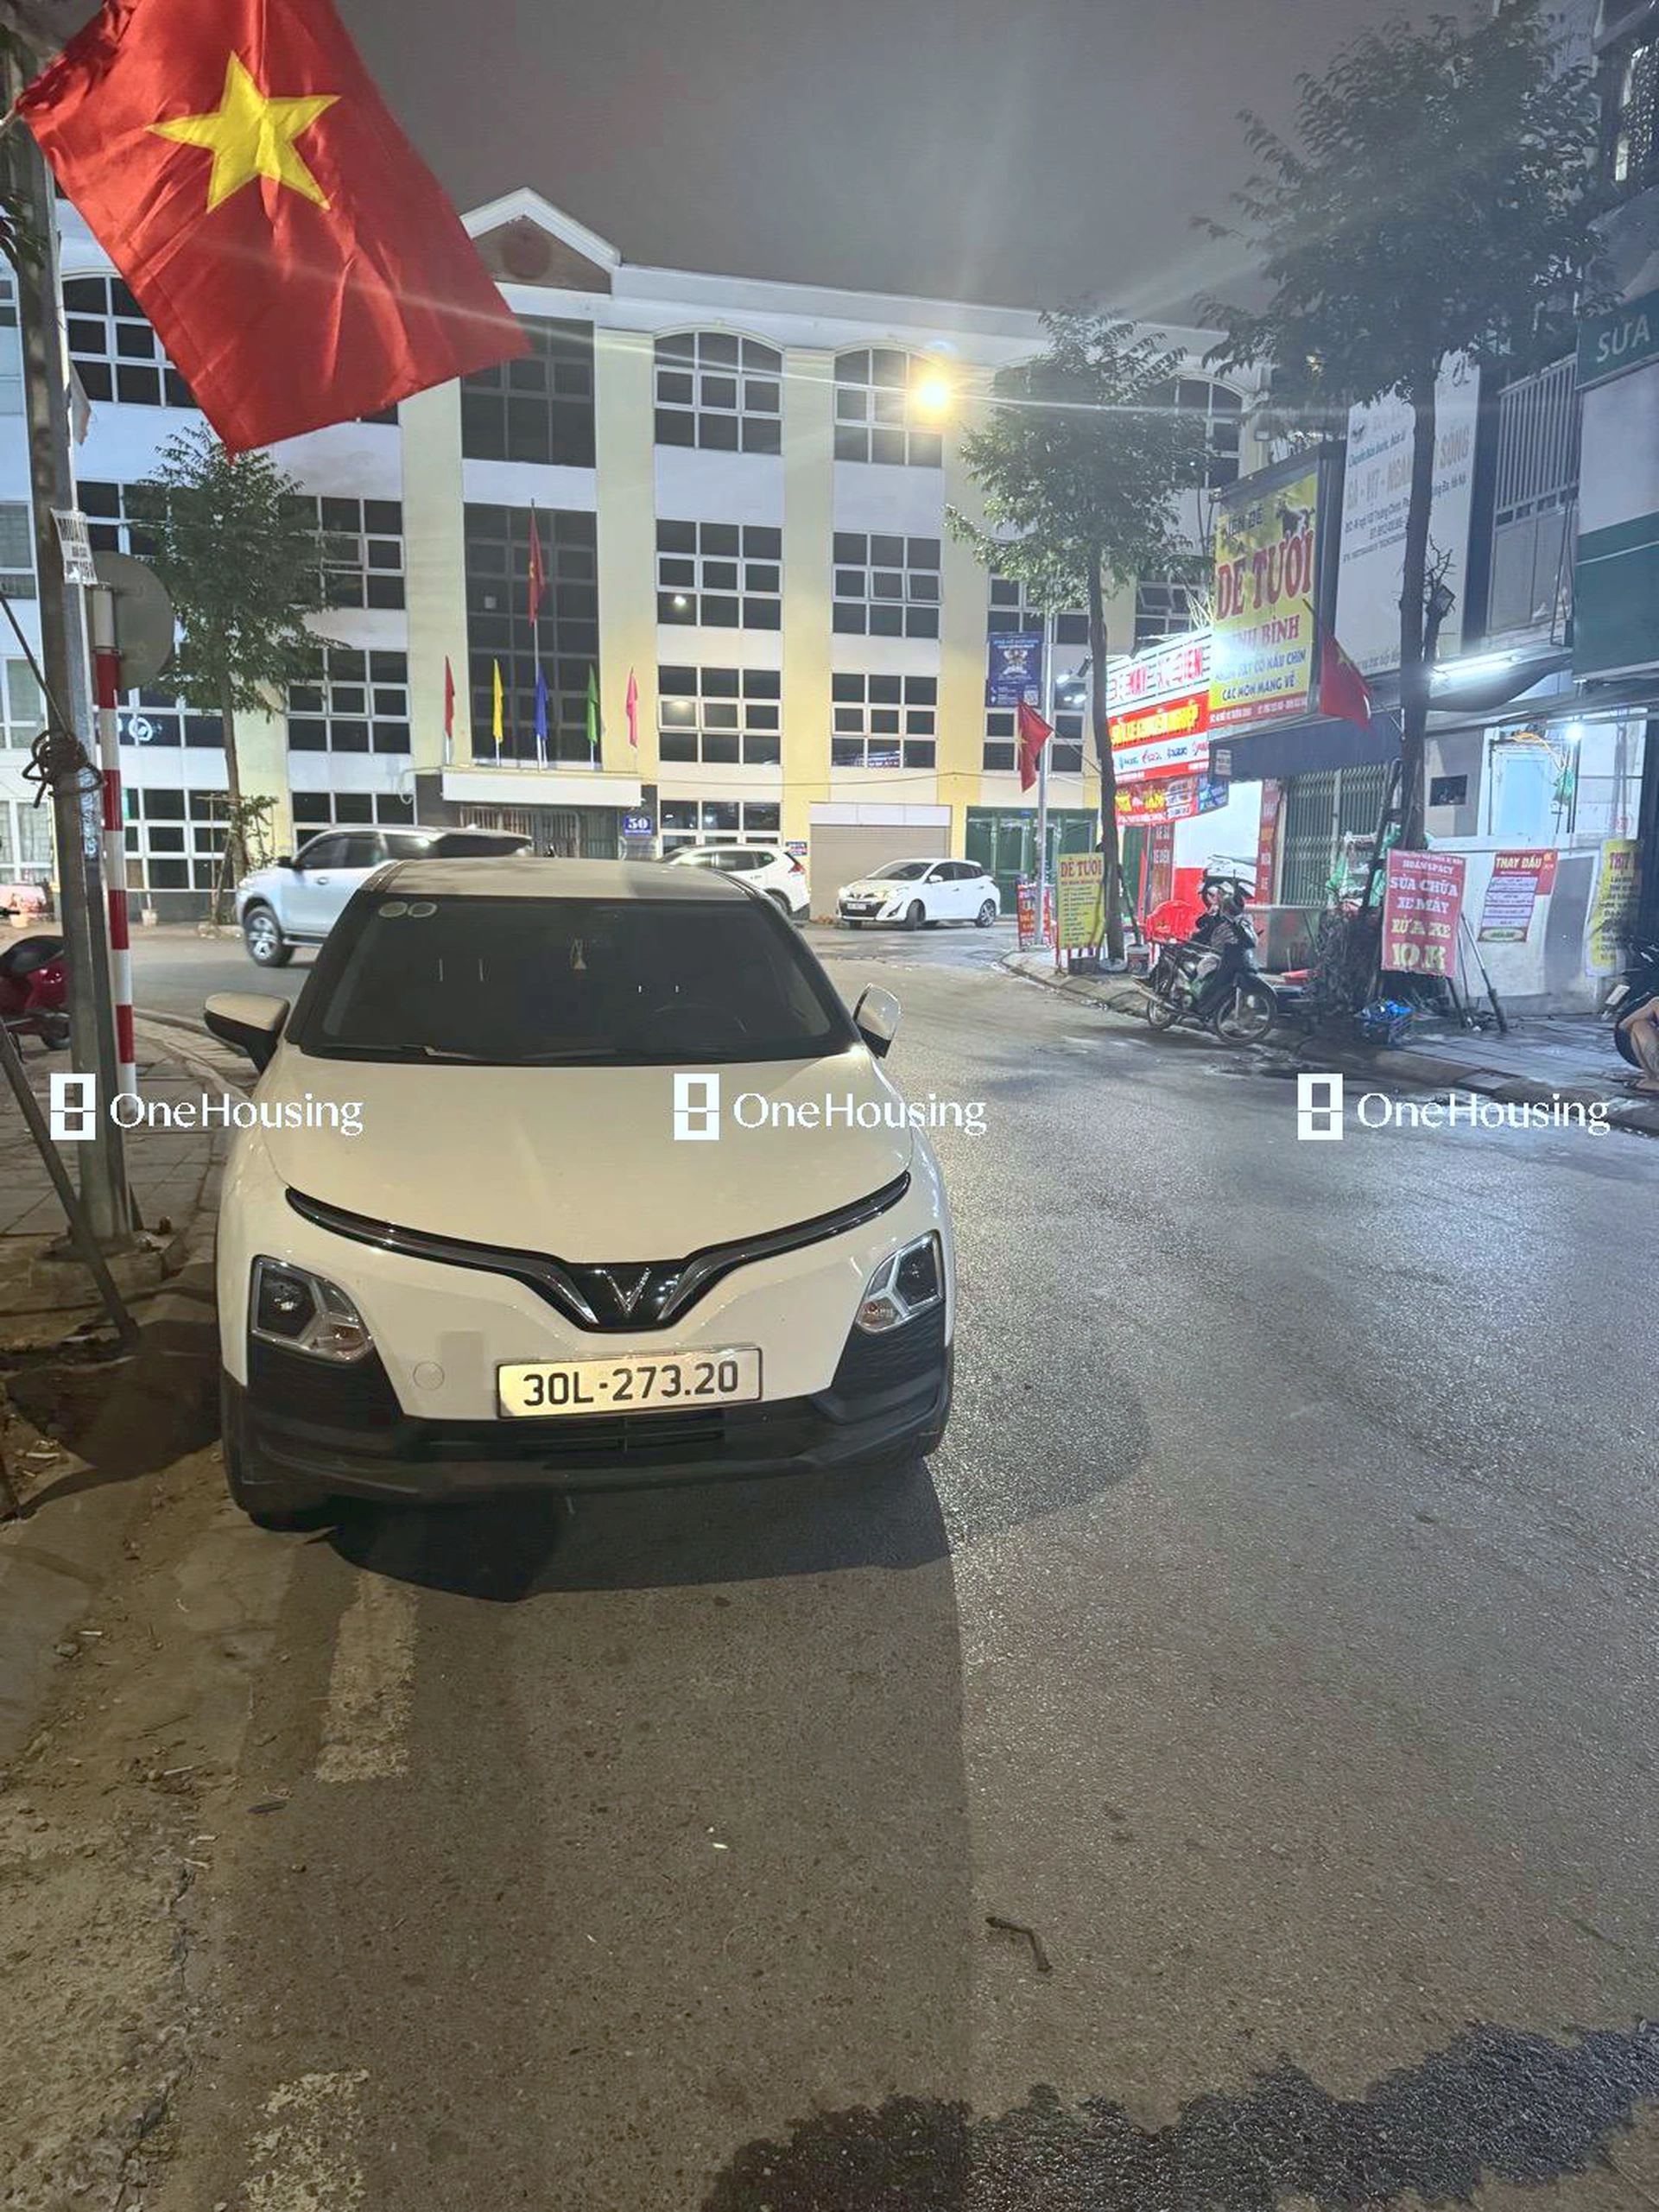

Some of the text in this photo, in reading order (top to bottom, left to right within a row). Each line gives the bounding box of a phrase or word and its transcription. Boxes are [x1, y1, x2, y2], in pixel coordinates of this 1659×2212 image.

[1262, 614, 1300, 645] BÌNH
[1257, 676, 1282, 694] MANG
[628, 817, 649, 829] 50
[1496, 857, 1520, 869] THAY
[1390, 873, 1459, 897] SỬA CHỮA
[1396, 897, 1450, 915] XE MÁY
[1391, 915, 1452, 939] RỬA XE
[1391, 942, 1421, 967] 10
[522, 1360, 738, 1406] 30L-273.20
